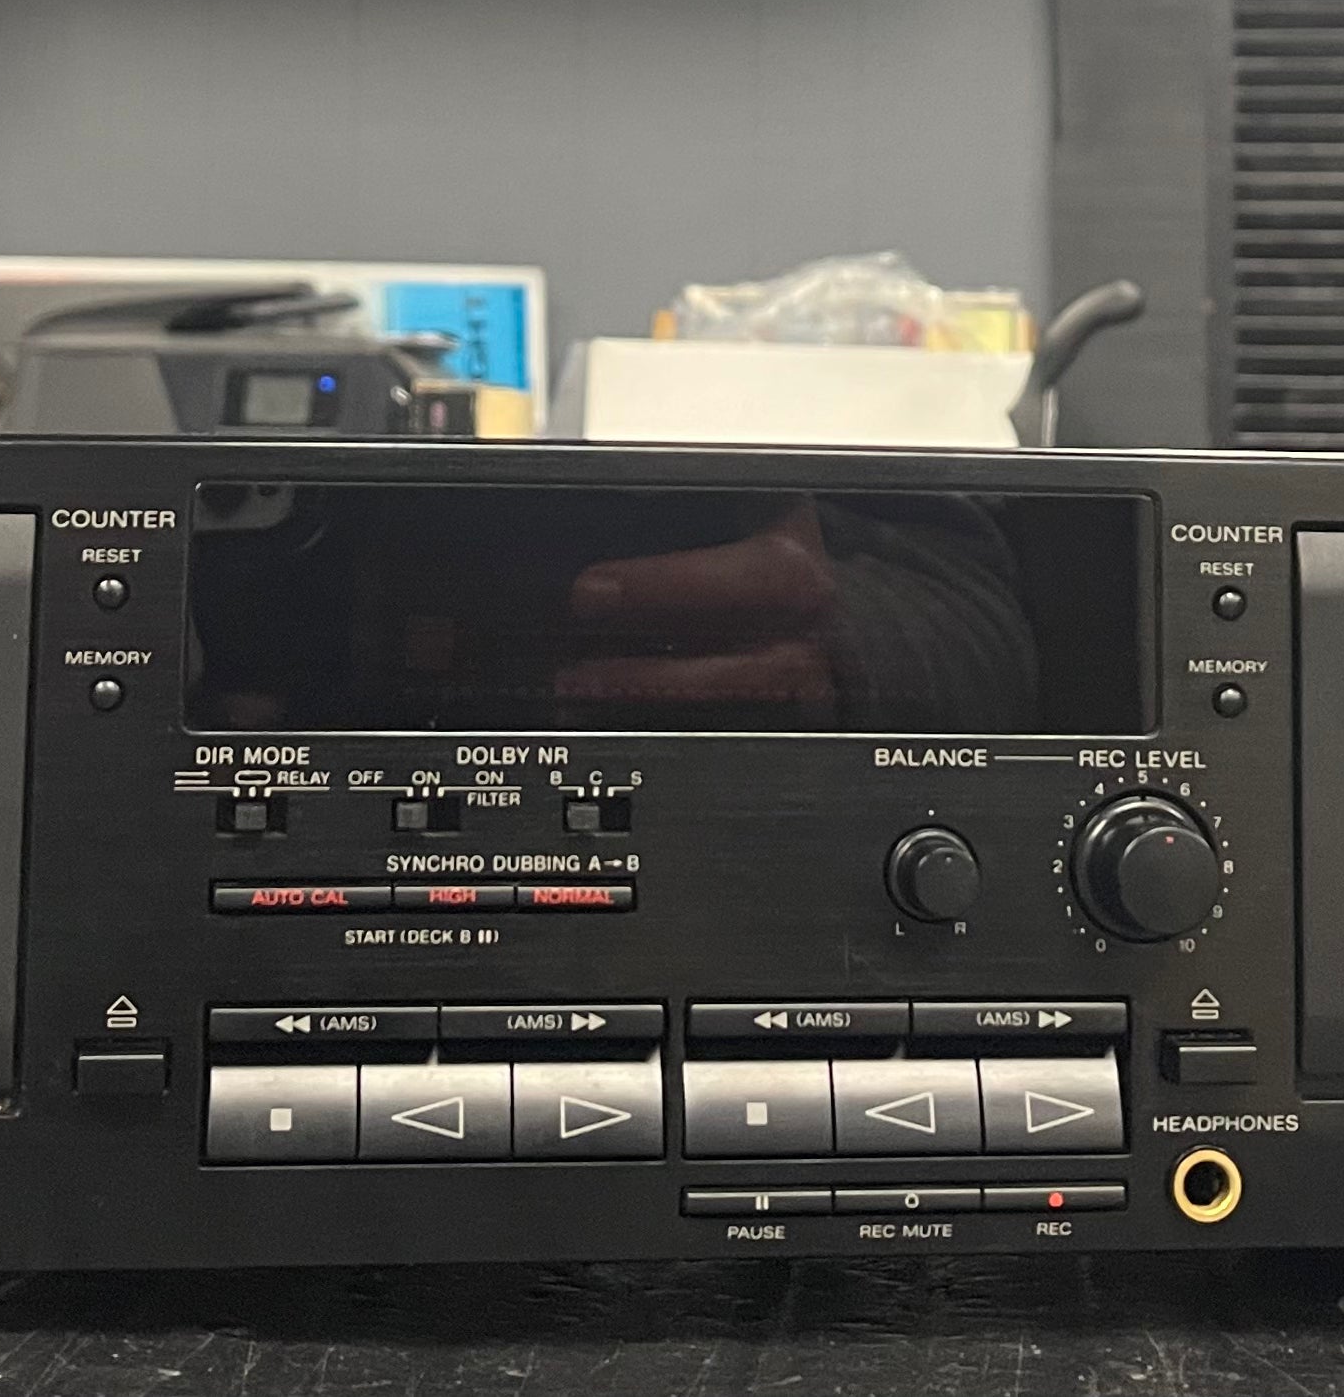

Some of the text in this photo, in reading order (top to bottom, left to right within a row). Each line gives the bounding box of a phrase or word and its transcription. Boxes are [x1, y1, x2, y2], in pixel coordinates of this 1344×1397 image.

[51, 508, 177, 529] COUNTER
[1170, 523, 1284, 544] COUNTER
[81, 548, 143, 563] RESET
[1199, 561, 1255, 577] RESET
[64, 650, 153, 666] MEMORY
[1187, 658, 1269, 674] MEMORY
[195, 746, 311, 765] DIR MODE
[456, 746, 569, 766] DOLBY NR
[874, 747, 988, 768] BALANCE
[1078, 749, 1207, 770] REC LEVEL
[276, 770, 331, 786] RELAY
[347, 770, 384, 786] OFF
[411, 770, 441, 786] ON
[474, 770, 505, 786] ON
[550, 771, 563, 785] B
[588, 771, 604, 786] C
[630, 771, 643, 786] S
[1137, 771, 1149, 785] 5
[1094, 782, 1105, 796] 4
[1180, 783, 1191, 797] 6
[466, 791, 521, 807] FILTER
[1063, 815, 1075, 829] 3
[1212, 816, 1222, 829] 7
[385, 854, 641, 873] SYNCHRO DUBBING A B
[1052, 859, 1064, 874] 2
[1222, 859, 1235, 875] 8
[250, 888, 349, 906] AUTO CAL
[428, 887, 478, 905] HIGH
[532, 887, 616, 905] NORMAL
[1212, 904, 1224, 919] 9
[344, 928, 473, 945] START (DECK B
[895, 922, 905, 937] L
[1095, 938, 1107, 953] 0
[1178, 938, 1197, 953] 10
[319, 1015, 378, 1033] (AMS)
[506, 1014, 564, 1032] (AMS)
[795, 1009, 852, 1030] (AMS)
[975, 1009, 1031, 1029] (AMS)
[1151, 1113, 1300, 1134] HEADPHONES
[726, 1223, 787, 1241] PAUSE
[858, 1221, 954, 1240] REC MUTE
[1035, 1220, 1073, 1237] REC
